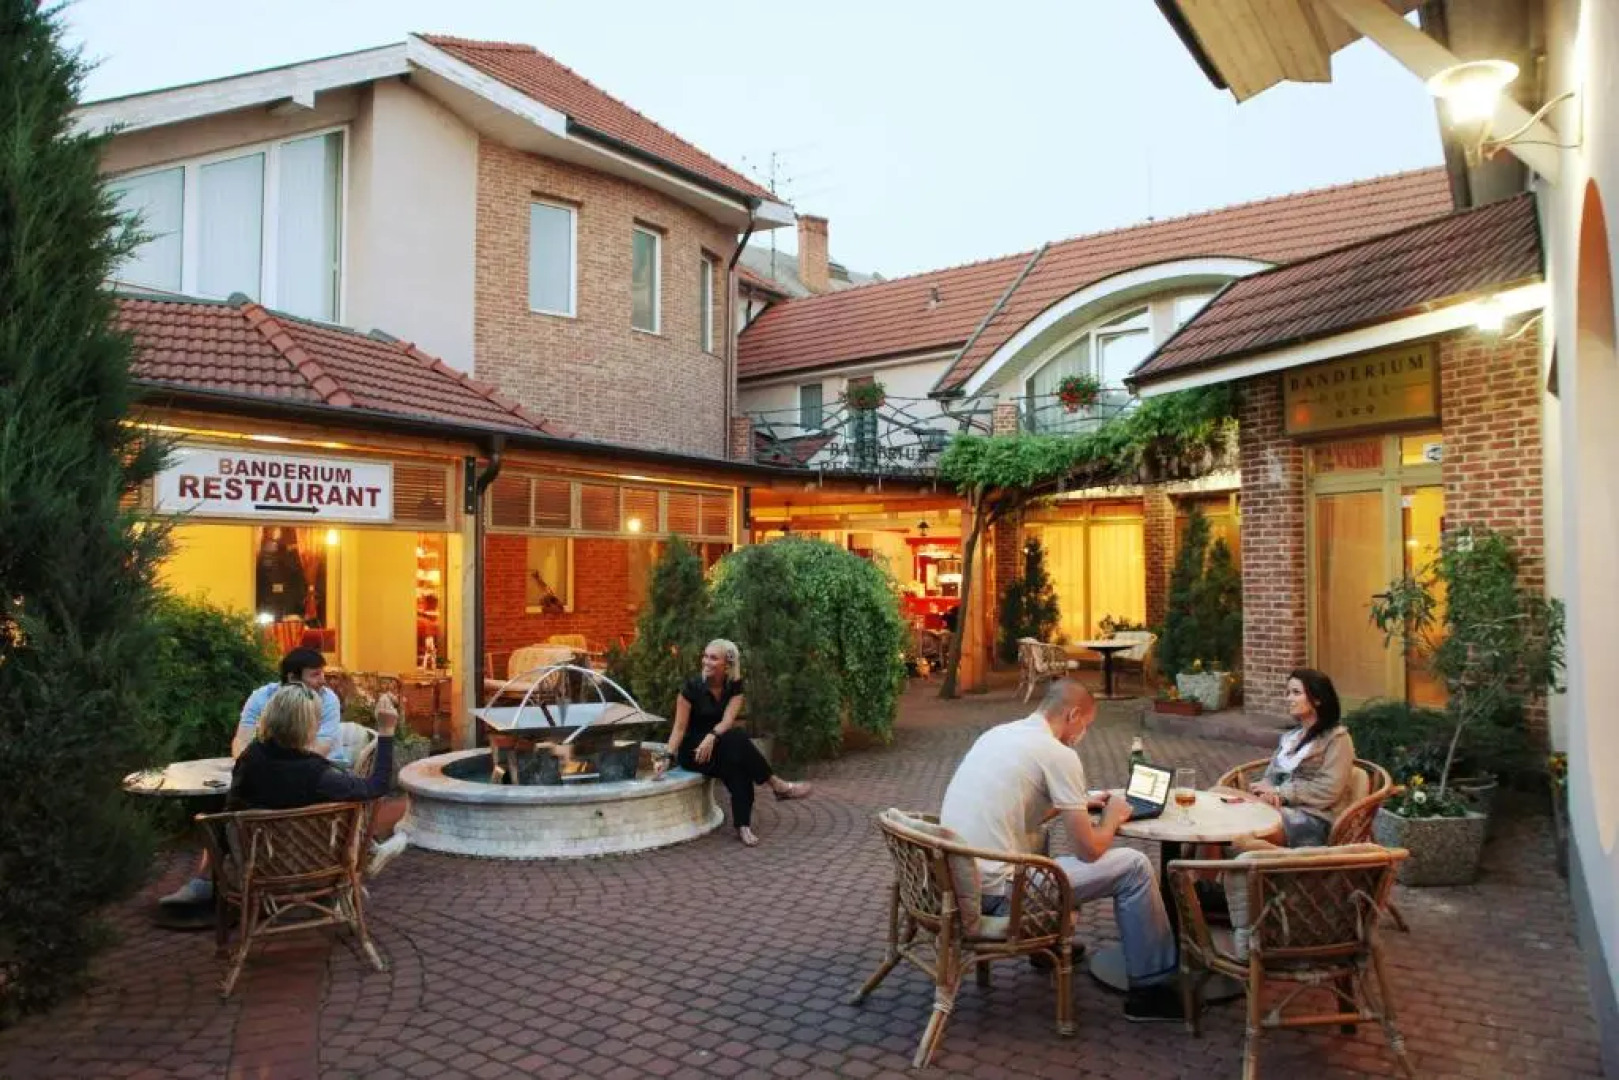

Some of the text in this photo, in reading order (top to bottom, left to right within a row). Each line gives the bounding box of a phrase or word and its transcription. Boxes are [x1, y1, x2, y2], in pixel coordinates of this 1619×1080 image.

[1290, 353, 1424, 392] BANDERIUM
[218, 458, 351, 483] BANDERIUM
[178, 474, 382, 507] RESTAURANT
